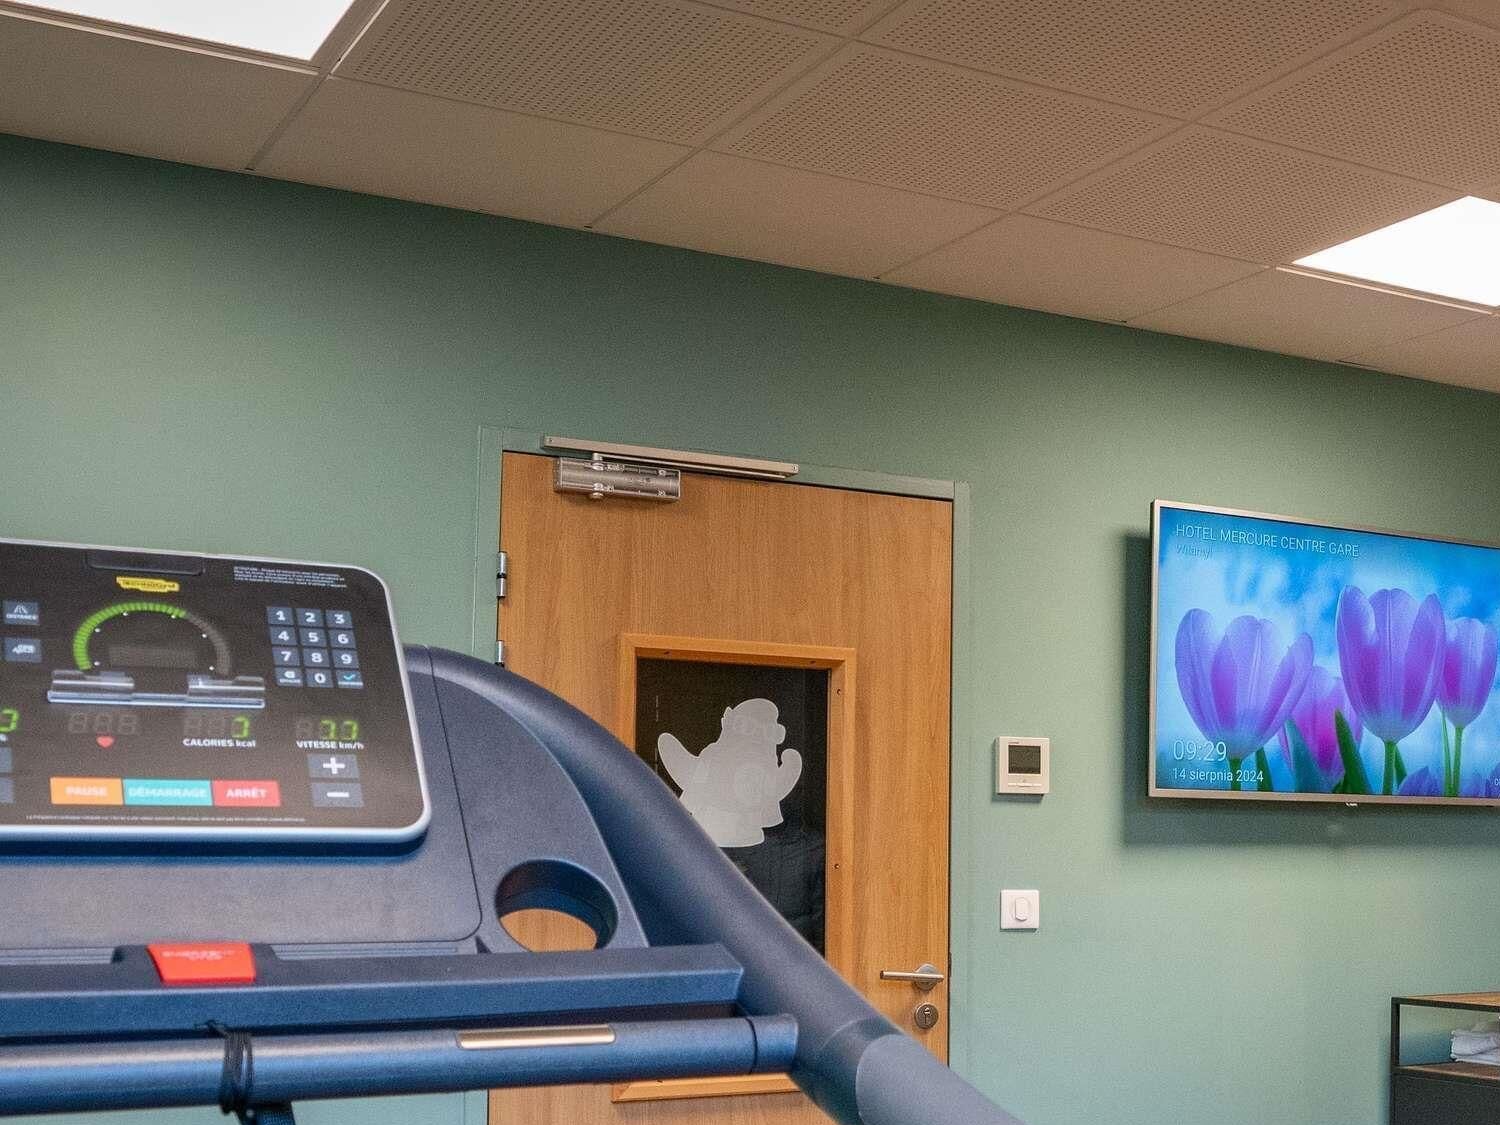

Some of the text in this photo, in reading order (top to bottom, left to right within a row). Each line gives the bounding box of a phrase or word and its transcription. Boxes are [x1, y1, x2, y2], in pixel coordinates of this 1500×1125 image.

[1175, 524, 1360, 557] HOTEL MERCURE CENTRE GARE
[276, 610, 286, 621] 1
[305, 612, 316, 623] 2
[334, 613, 345, 624] 3
[278, 630, 289, 641] 4
[308, 632, 319, 642] 5
[337, 633, 349, 644] 6
[281, 651, 292, 661] 7
[311, 652, 323, 663] 8
[341, 653, 352, 664] 9
[182, 738, 257, 748] CALORIES kcal
[296, 740, 365, 750] VITESSE km/h
[1173, 740, 1227, 761] 09:29
[1173, 767, 1264, 782] 14 sierpnia 2024
[65, 786, 108, 797] PAUSE
[128, 784, 209, 798] DÉMARRAGE
[226, 785, 268, 799] ARRÊT
